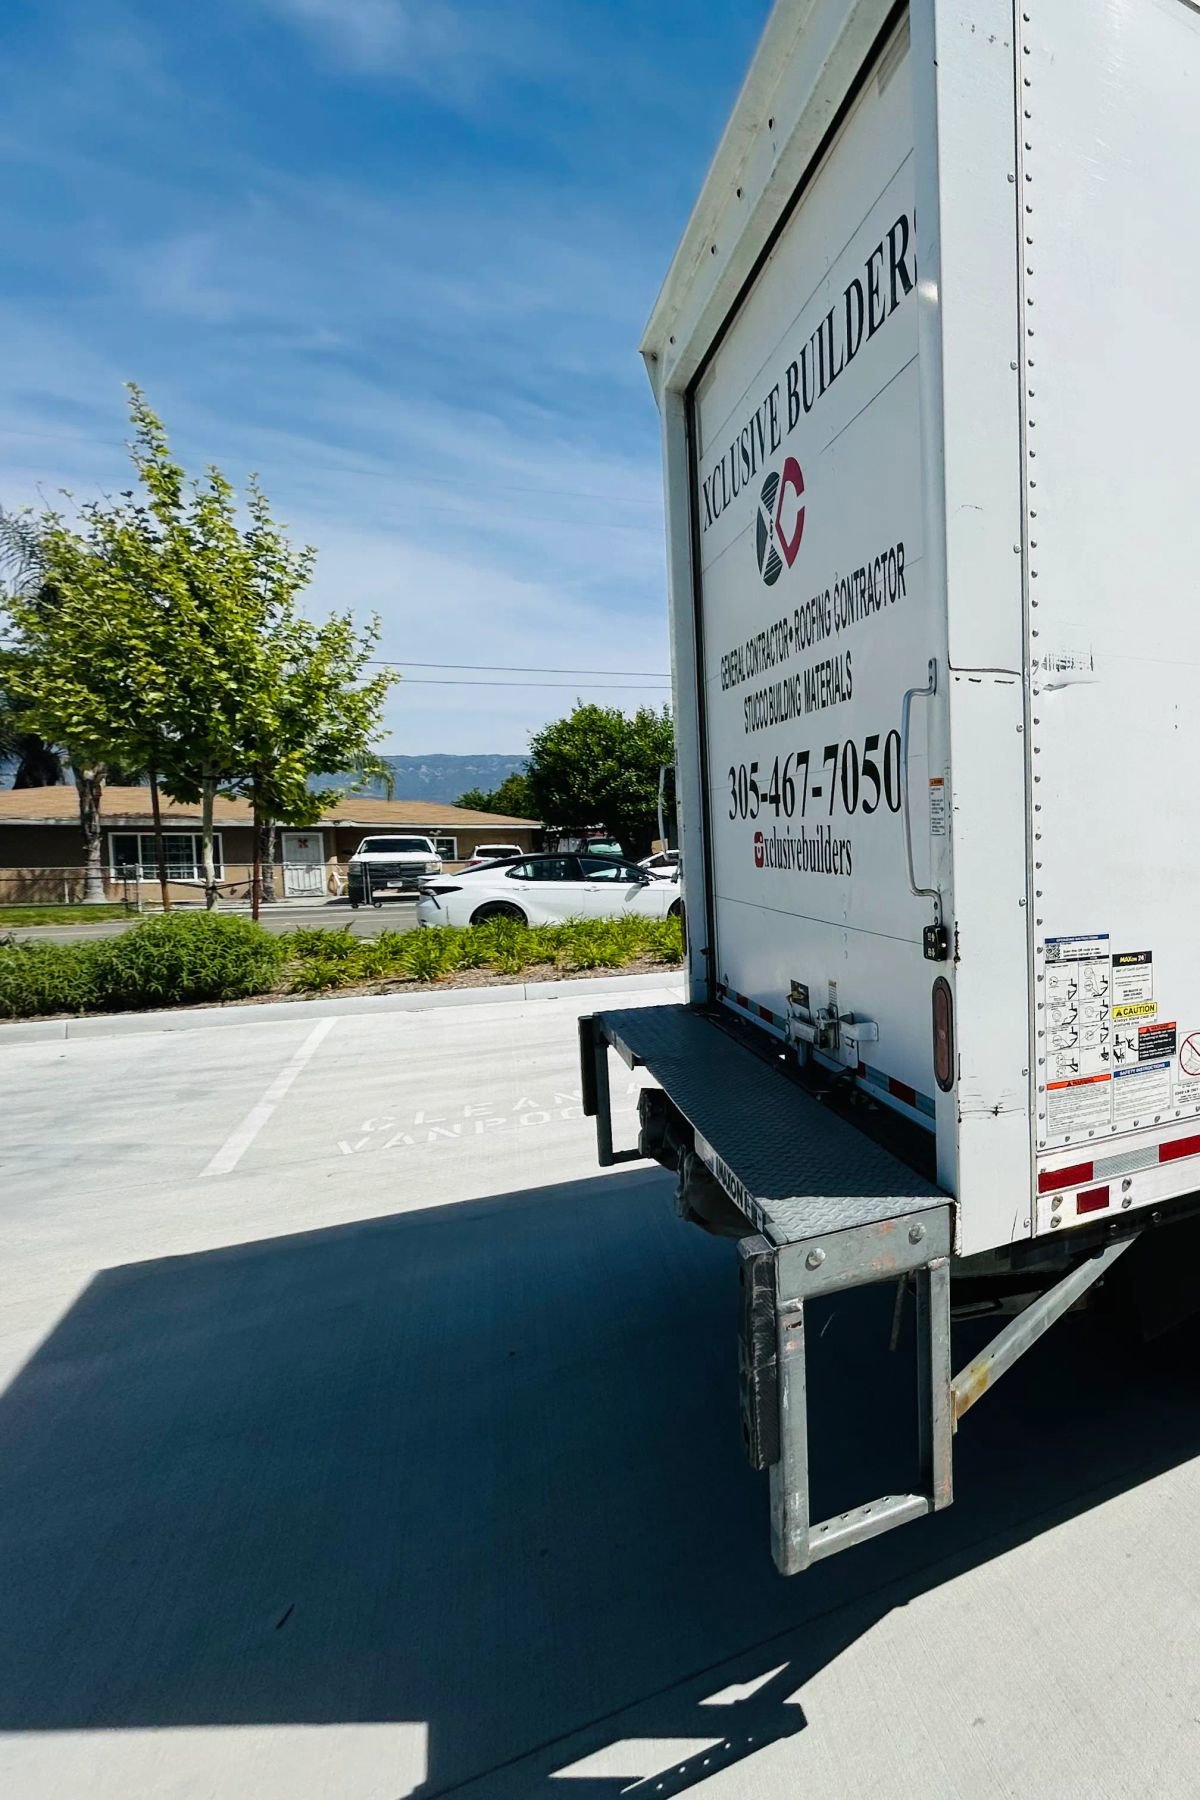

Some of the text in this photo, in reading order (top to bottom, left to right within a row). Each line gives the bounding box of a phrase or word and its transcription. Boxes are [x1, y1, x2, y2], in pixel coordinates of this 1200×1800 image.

[702, 206, 918, 534] XCLUSIVE BUILDER
[721, 541, 906, 691] GENERAL CONTRACTOR ROOFING CONTRACTOR
[744, 650, 853, 735] STUCCO BUILDING MATERIALS
[728, 728, 902, 821] 305-467-7050
[764, 825, 853, 877] xclusivebuilders
[1123, 1004, 1155, 1015] CAUTION
[336, 1107, 638, 1155] VANPOO
[360, 1089, 583, 1132] CLEAN
